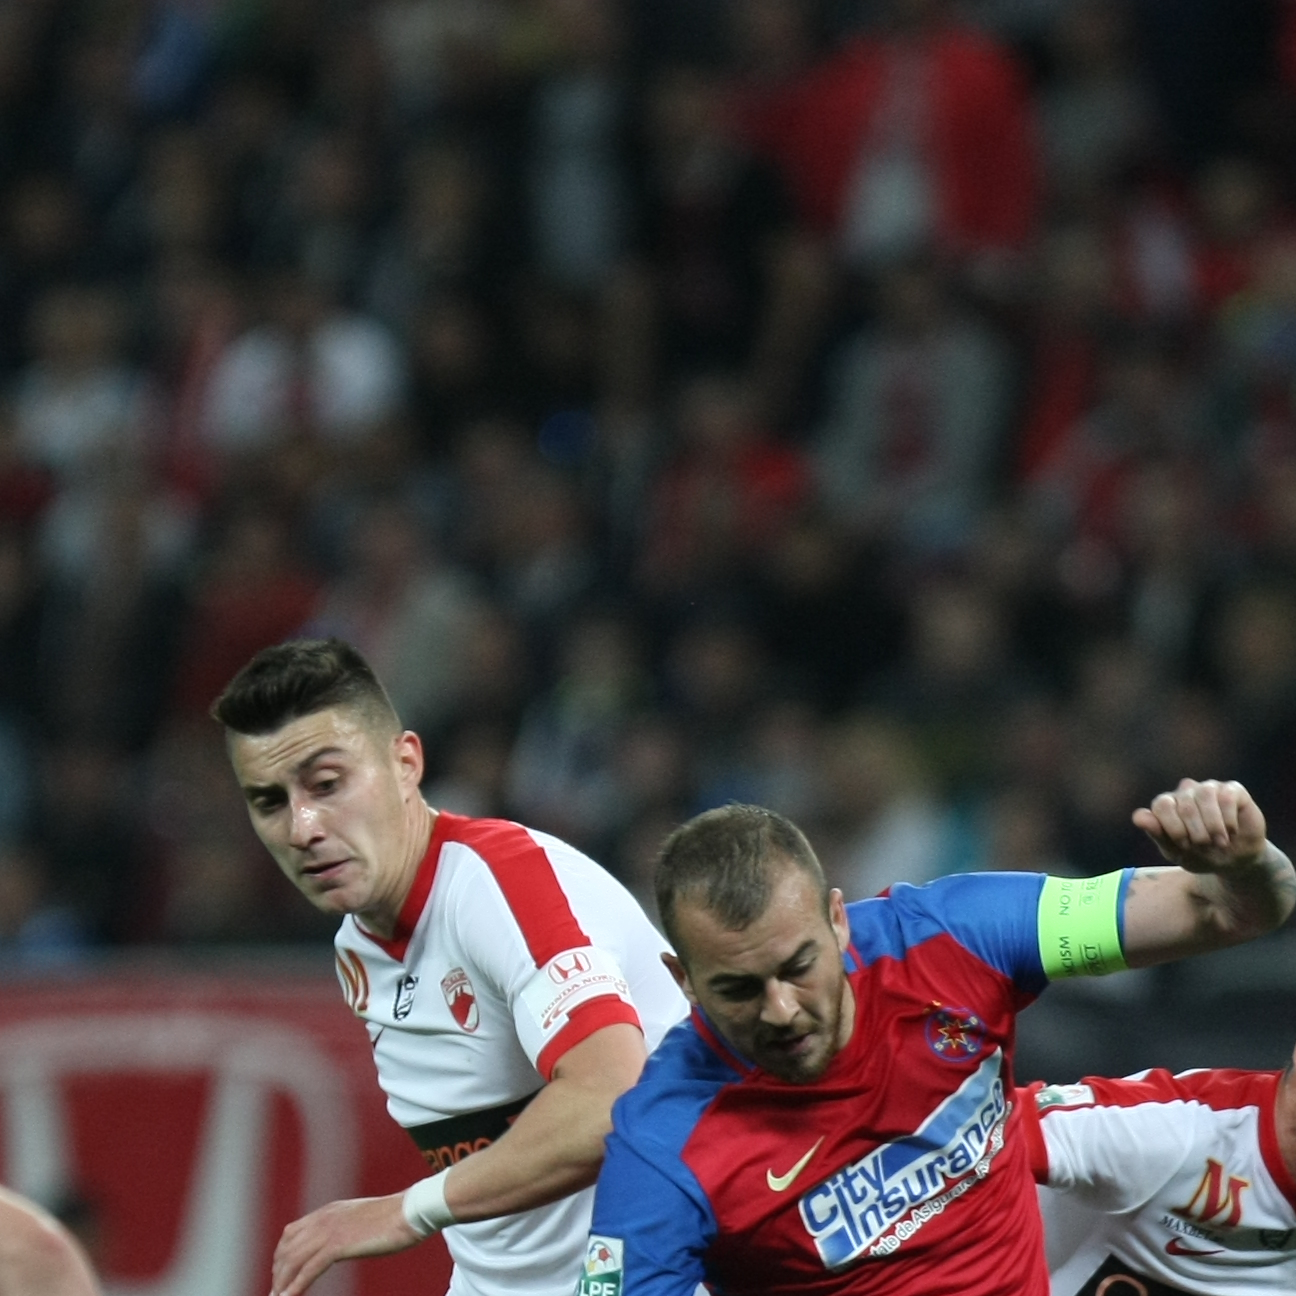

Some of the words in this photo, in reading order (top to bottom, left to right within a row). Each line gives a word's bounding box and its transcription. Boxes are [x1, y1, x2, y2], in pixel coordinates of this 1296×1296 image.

[541, 980, 581, 1018] HONDA
[802, 1153, 885, 1233] City
[835, 1080, 1003, 1248] Insurance
